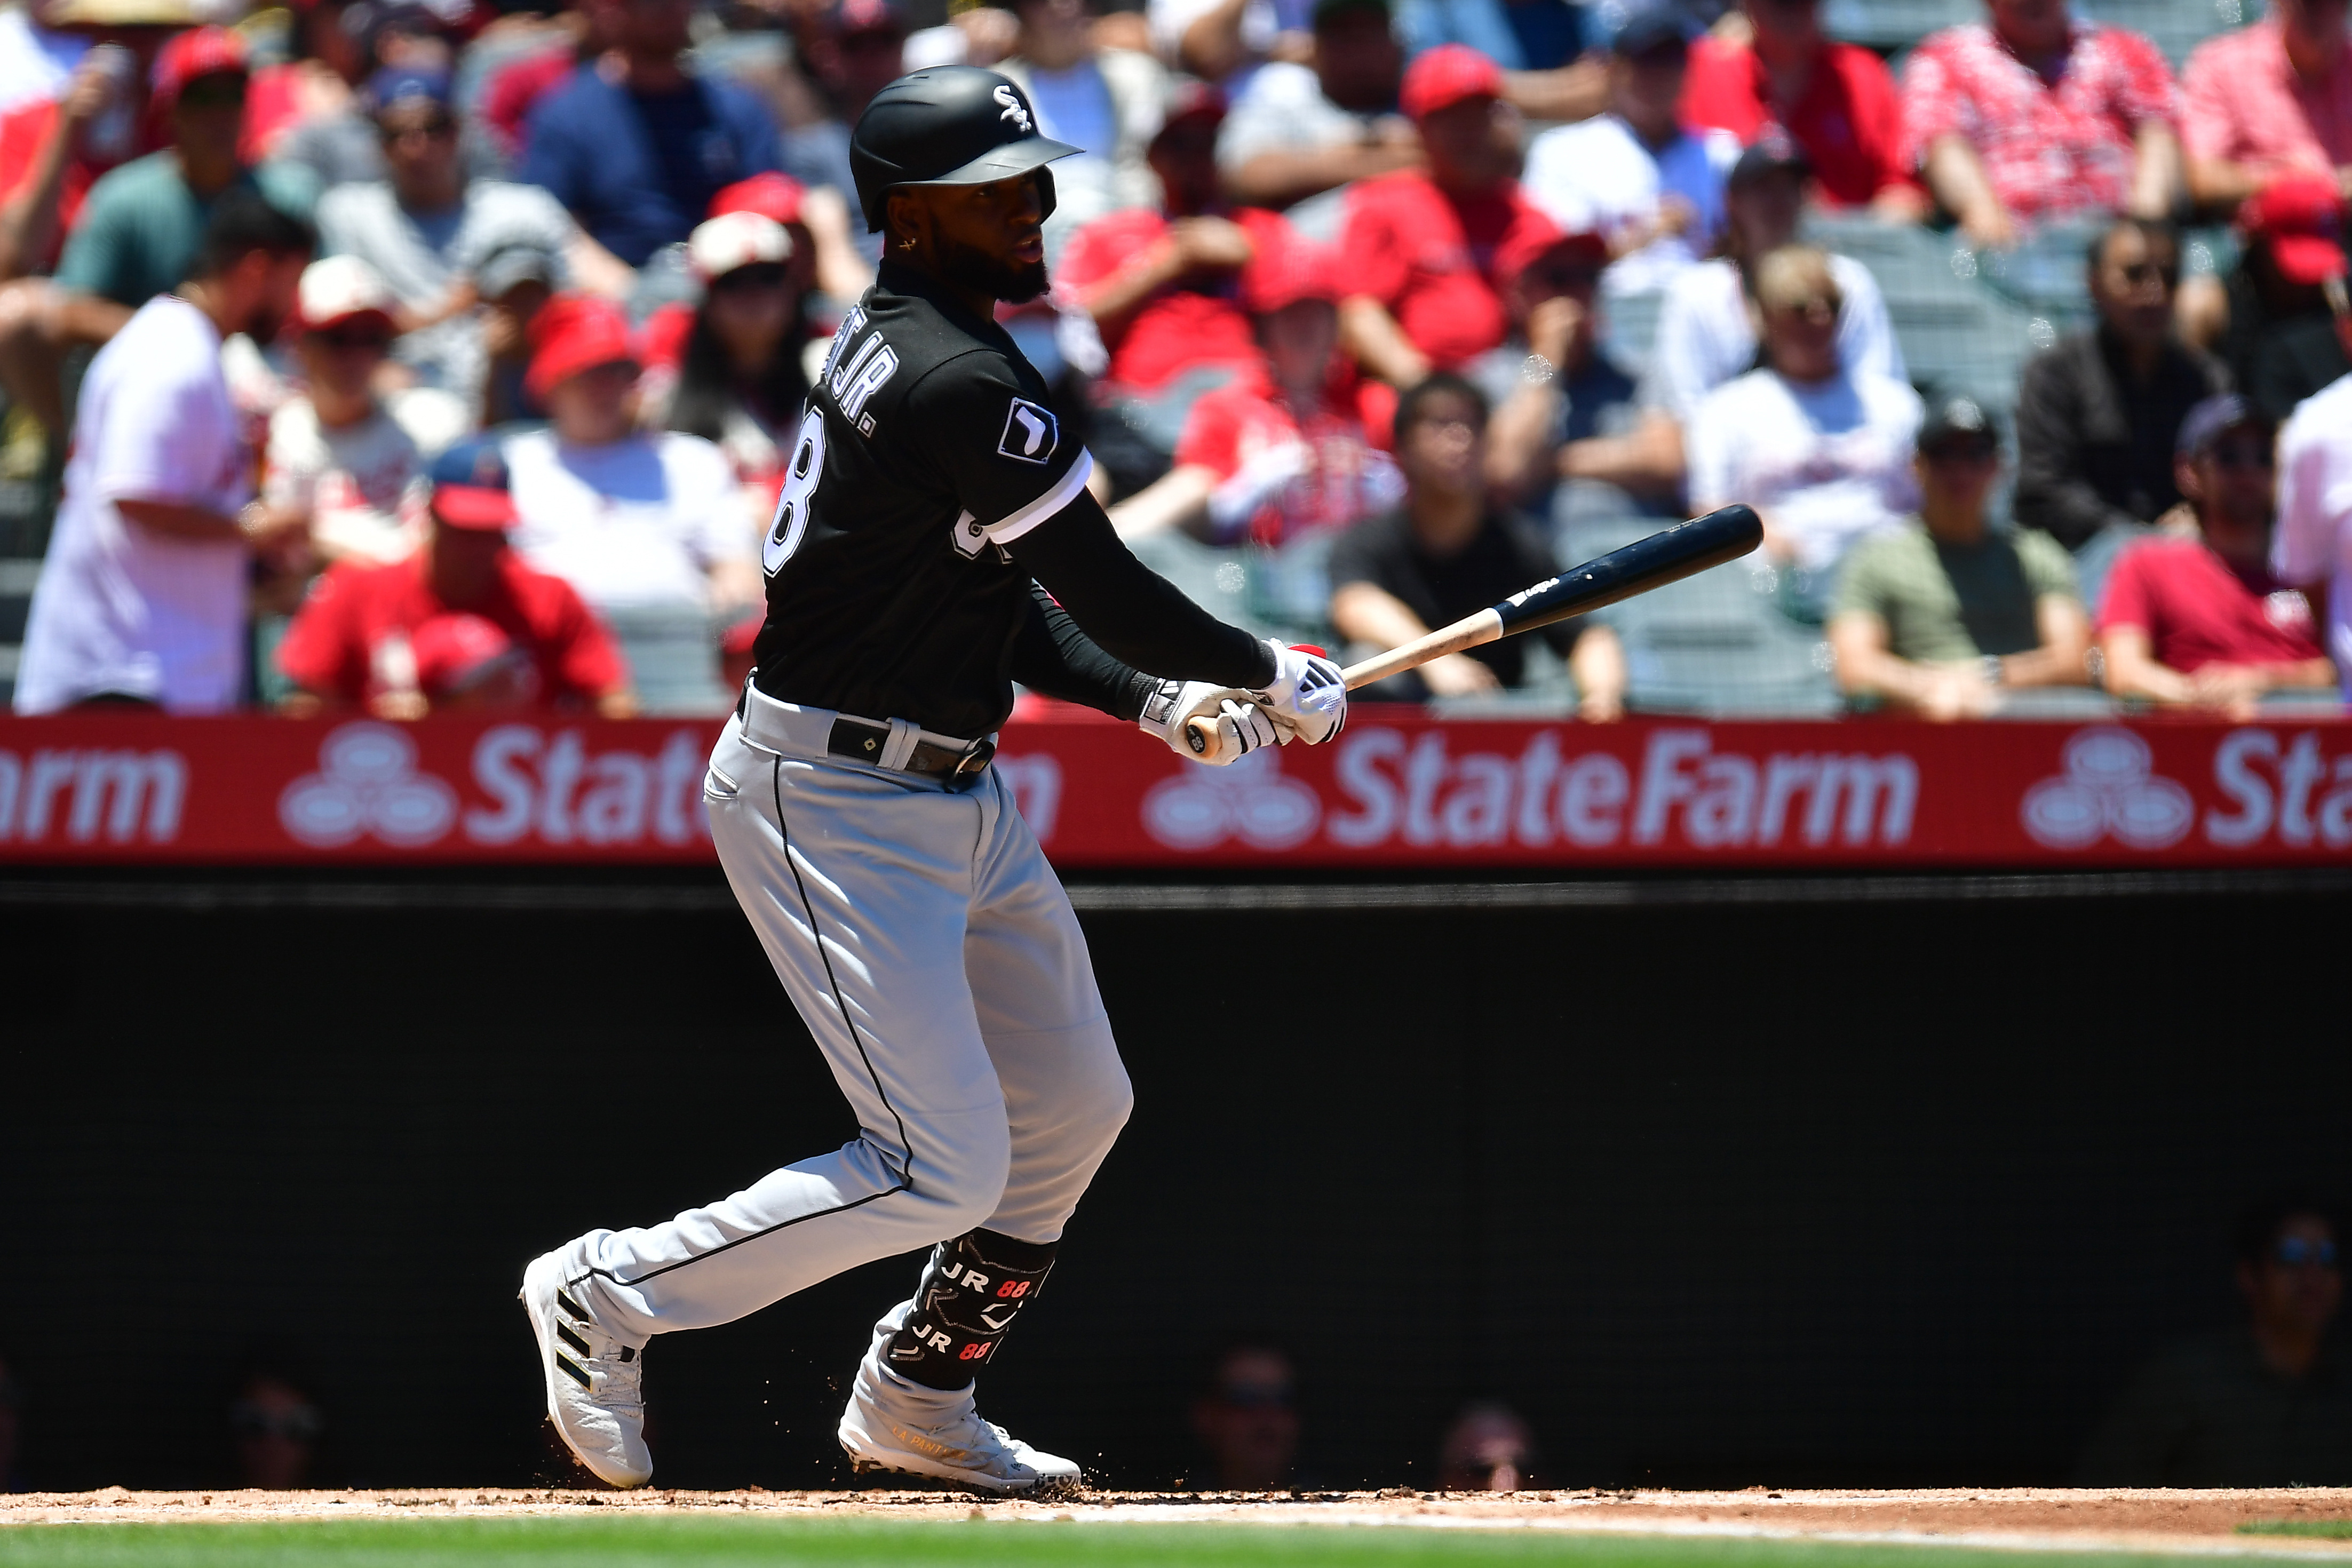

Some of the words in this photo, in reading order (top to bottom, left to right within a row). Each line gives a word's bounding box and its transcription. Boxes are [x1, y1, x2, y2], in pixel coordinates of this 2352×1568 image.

[464, 727, 711, 847] Stat
[941, 1262, 989, 1293] JR
[997, 1280, 1030, 1298] 88
[912, 1324, 952, 1354] JR
[958, 1341, 992, 1360] 88
